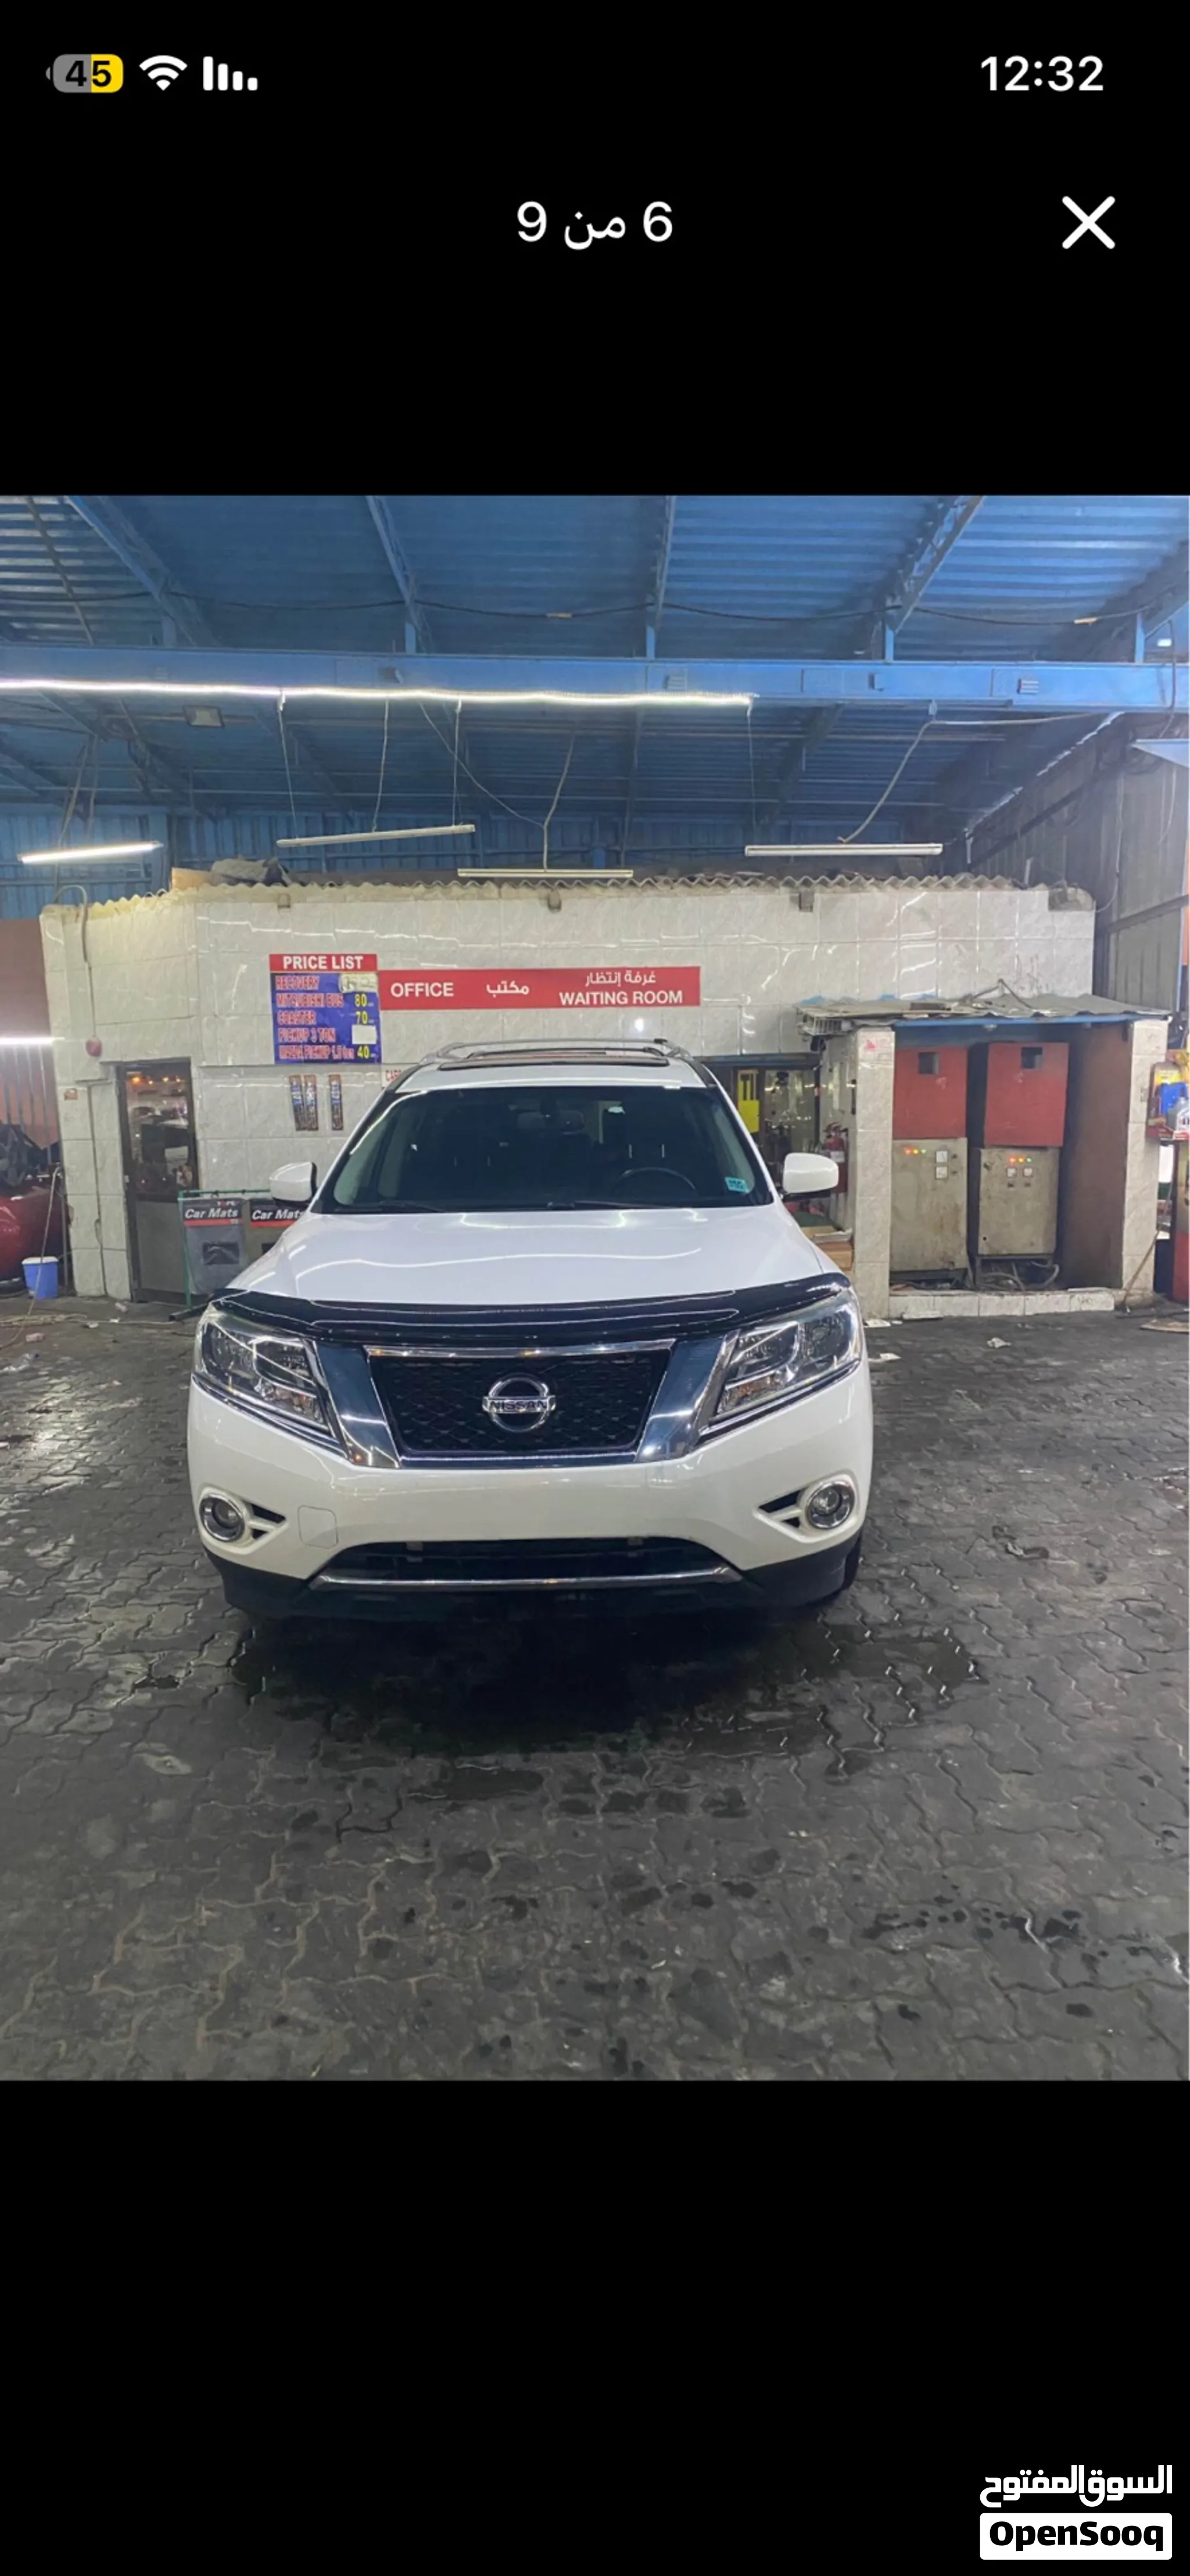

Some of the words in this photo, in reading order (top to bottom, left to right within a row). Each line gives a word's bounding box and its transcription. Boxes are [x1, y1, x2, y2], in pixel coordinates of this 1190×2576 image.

[282, 956, 328, 969] PRICE
[331, 956, 364, 969] LIST
[275, 975, 320, 990] RECOVERY
[624, 970, 657, 986] غرفة
[390, 982, 454, 998] OFFICE
[486, 980, 530, 998] مكتب
[276, 993, 325, 1008] MITSUBISHI
[326, 993, 345, 1008] BUS
[355, 993, 367, 1007] 80
[559, 991, 628, 1006] WAITING
[632, 990, 683, 1004] ROOM
[277, 1010, 317, 1025] COASTER
[356, 1011, 368, 1024] 70
[278, 1027, 310, 1042] PICKUP
[317, 1027, 336, 1042] TON
[357, 1045, 370, 1059] 40
[184, 1208, 205, 1219] Car
[207, 1208, 239, 1219] Mats
[252, 1209, 272, 1220] Car
[489, 1399, 547, 1411] NISSAN
